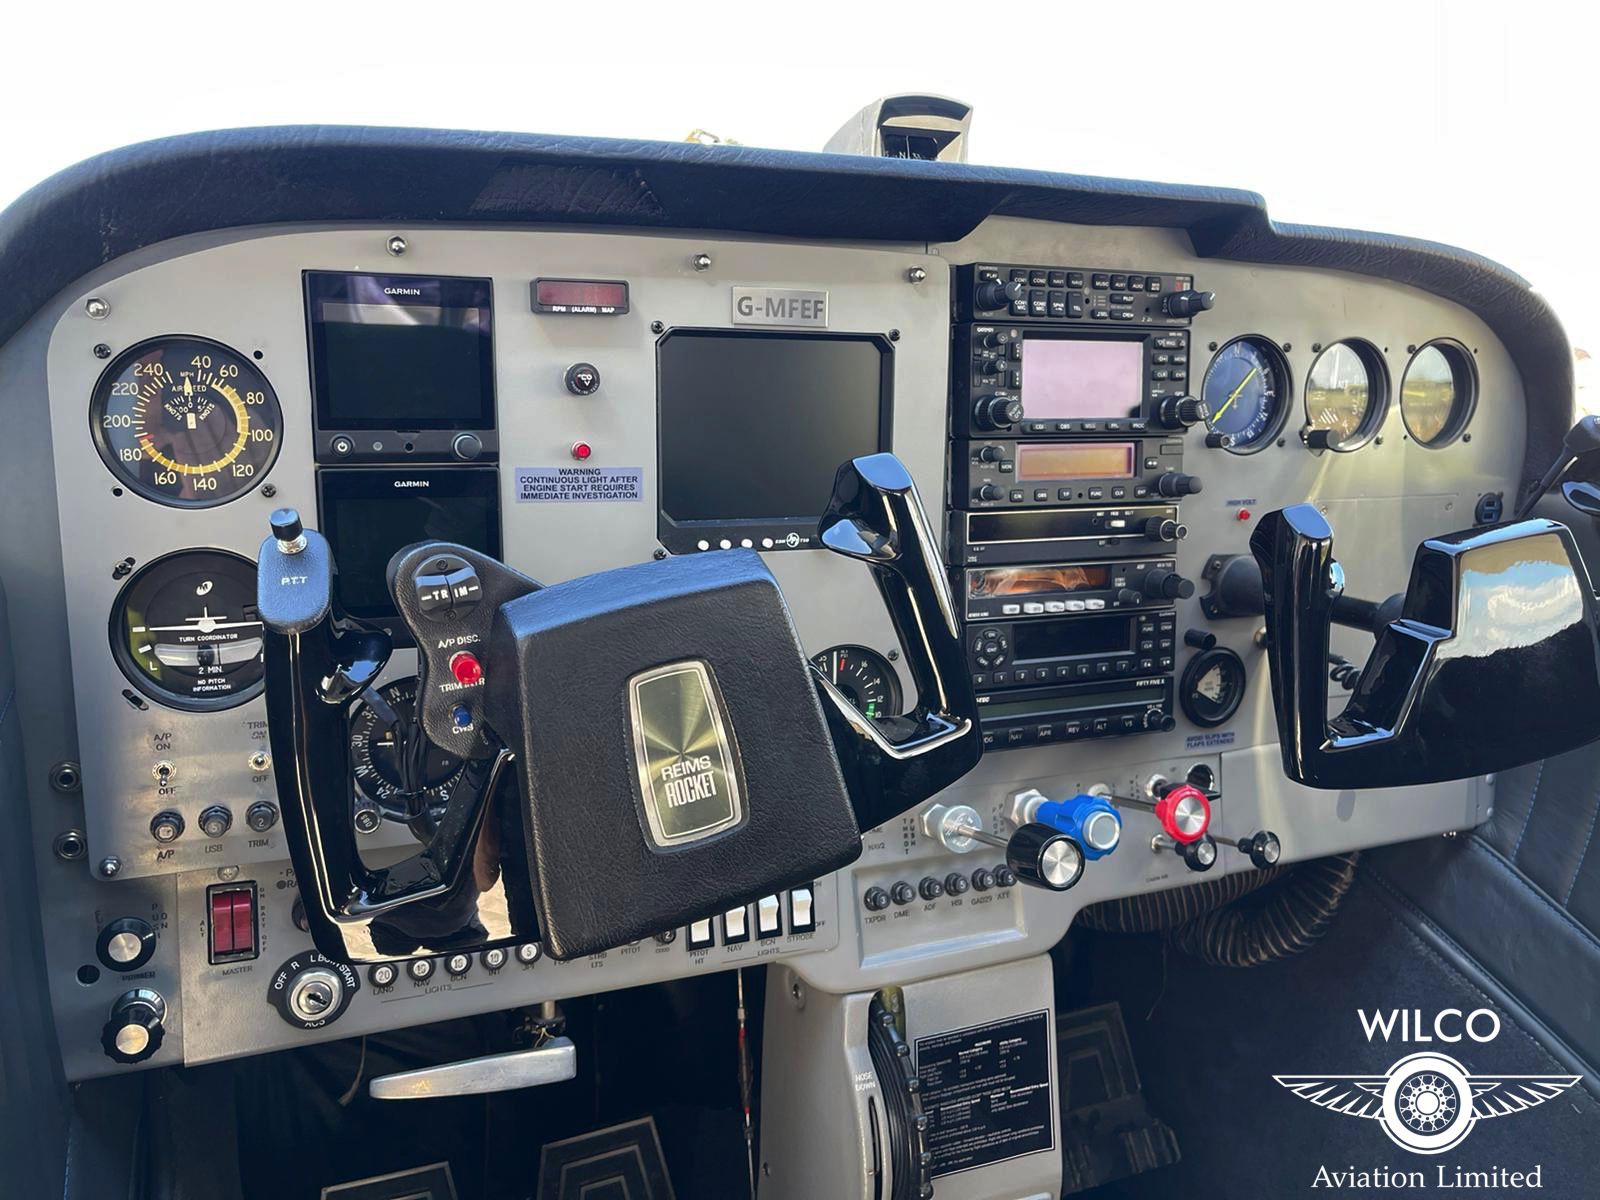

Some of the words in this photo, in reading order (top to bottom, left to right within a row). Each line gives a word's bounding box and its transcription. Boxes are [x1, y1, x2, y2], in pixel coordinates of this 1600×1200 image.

[384, 288, 420, 296] GARMIN
[737, 296, 824, 320] G-MFEF
[191, 355, 211, 368] 40
[134, 364, 163, 376] 240
[219, 365, 238, 378] 60
[112, 383, 139, 395] 220
[246, 392, 264, 404] 80
[164, 403, 182, 420] KNOTS
[199, 403, 216, 420] KNOTS
[103, 415, 130, 428] 200
[251, 429, 273, 442] 100
[120, 448, 142, 461] 180
[232, 464, 254, 477] 120
[154, 472, 177, 485] 160
[193, 478, 217, 490] 140
[198, 633, 238, 642] COORDINATOR
[438, 638, 455, 648] A/P
[457, 634, 480, 645] DISC.
[150, 662, 157, 670] L
[390, 687, 400, 697] N
[439, 682, 464, 693] TRIM
[154, 733, 172, 741] A/P
[352, 735, 363, 749] 30
[355, 765, 368, 778] W
[661, 756, 711, 781] REIMS
[376, 786, 390, 799] 24
[440, 790, 449, 800] S
[664, 771, 717, 808] ROCKET
[205, 845, 223, 853] USB
[248, 840, 269, 848] TRIM
[157, 850, 174, 860] A/P
[924, 902, 936, 911] ADF
[865, 915, 886, 924] TXPDR
[894, 910, 910, 919] DME
[161, 912, 168, 929] ON
[787, 932, 814, 942] STROBE
[490, 953, 499, 962] 10
[757, 948, 780, 956] LIGHTS
[291, 961, 300, 970] R
[416, 964, 426, 973] 10
[454, 958, 463, 968] 10
[223, 966, 253, 976] MASTER
[339, 964, 356, 988] START
[378, 970, 390, 981] 20
[274, 972, 288, 990] OFF
[373, 987, 394, 996] LAND
[425, 984, 451, 994] LIGHTS
[856, 1072, 873, 1082] NOSE
[856, 1082, 876, 1091] DOWN
